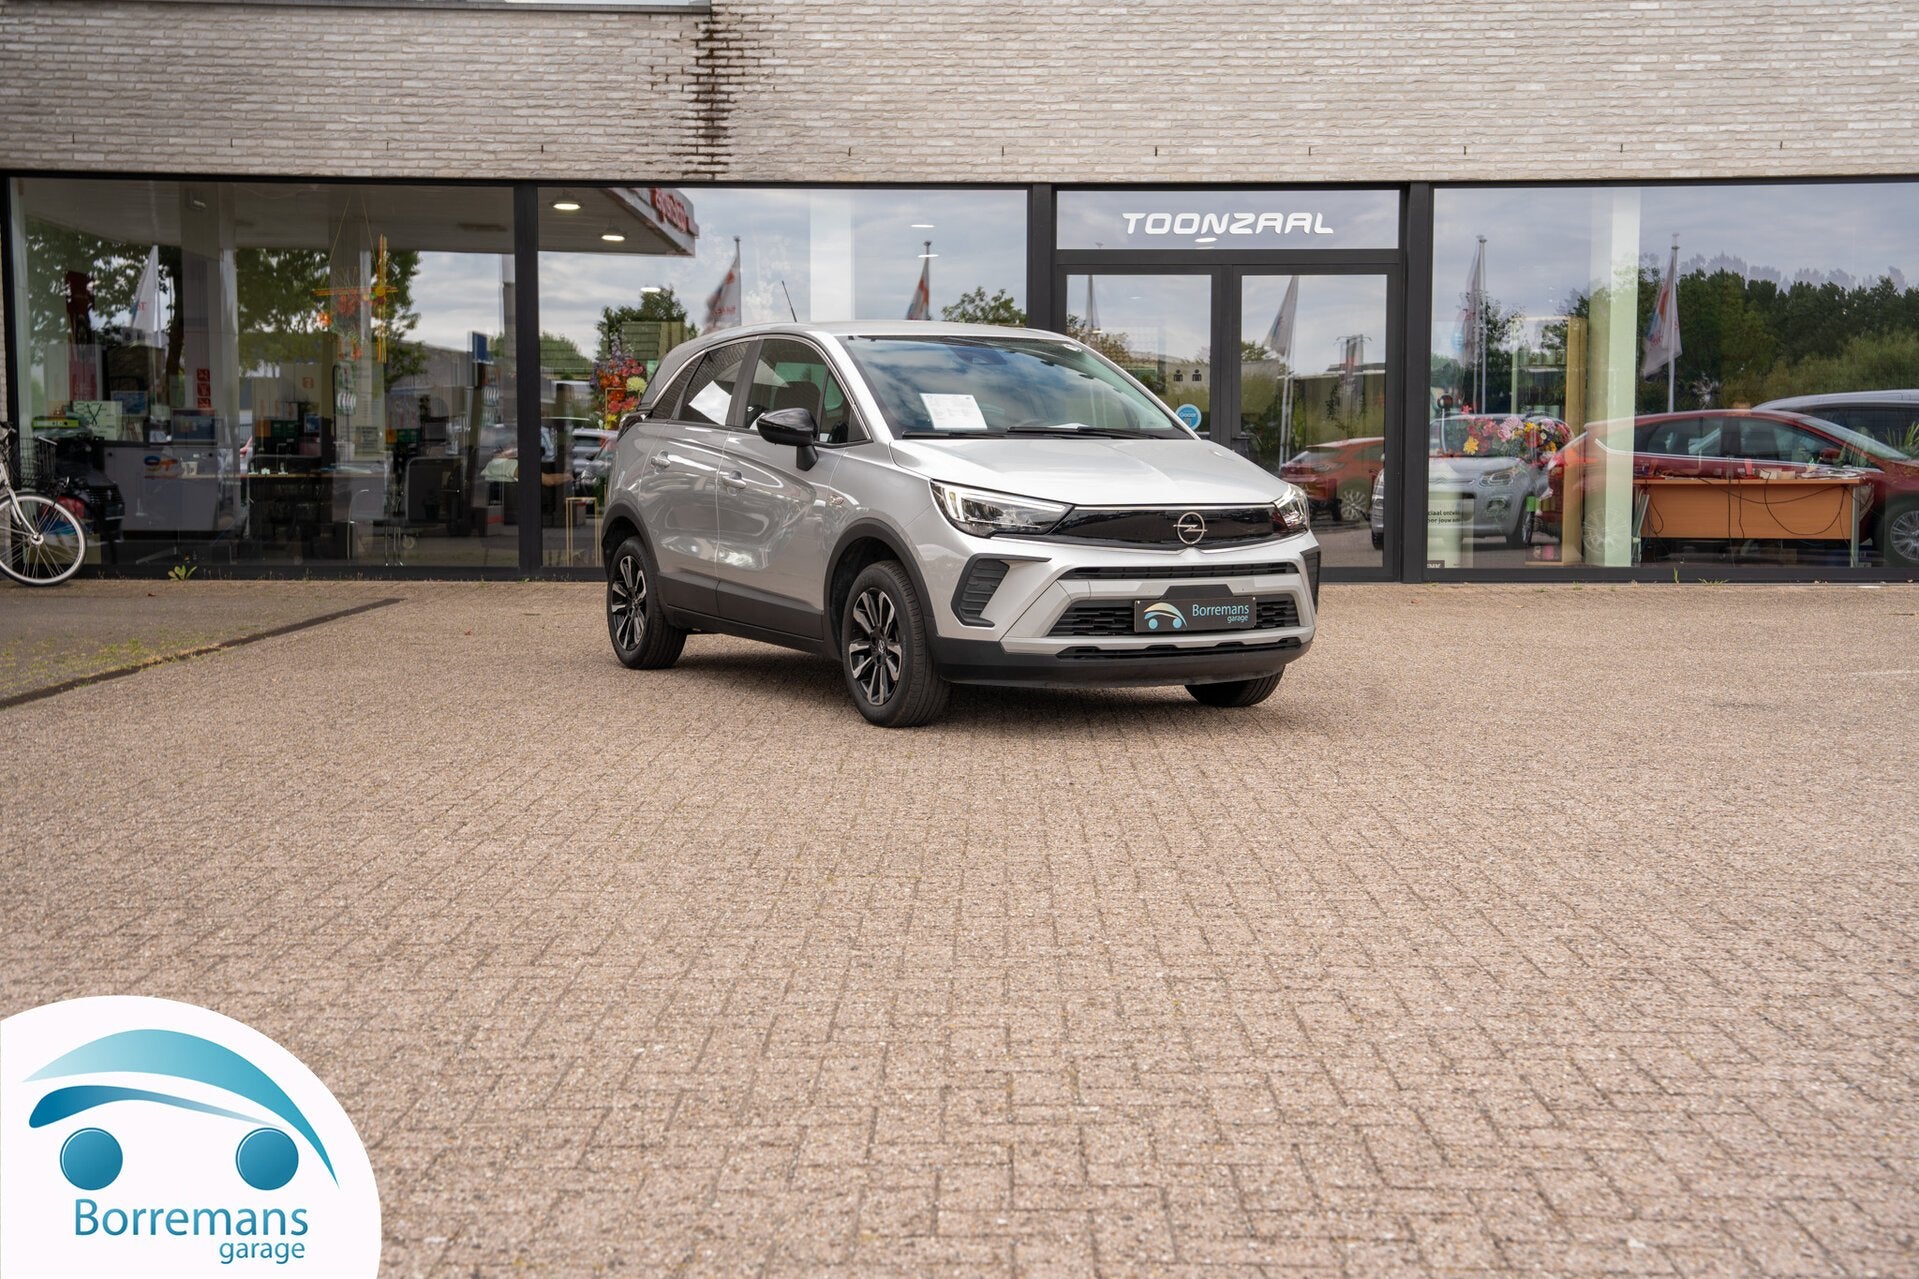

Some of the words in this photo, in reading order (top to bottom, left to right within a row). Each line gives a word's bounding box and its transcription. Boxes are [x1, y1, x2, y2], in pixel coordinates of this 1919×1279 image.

[1121, 212, 1334, 235] TOONZAAL
[1192, 603, 1249, 617] Borremans
[1226, 615, 1249, 624] garage
